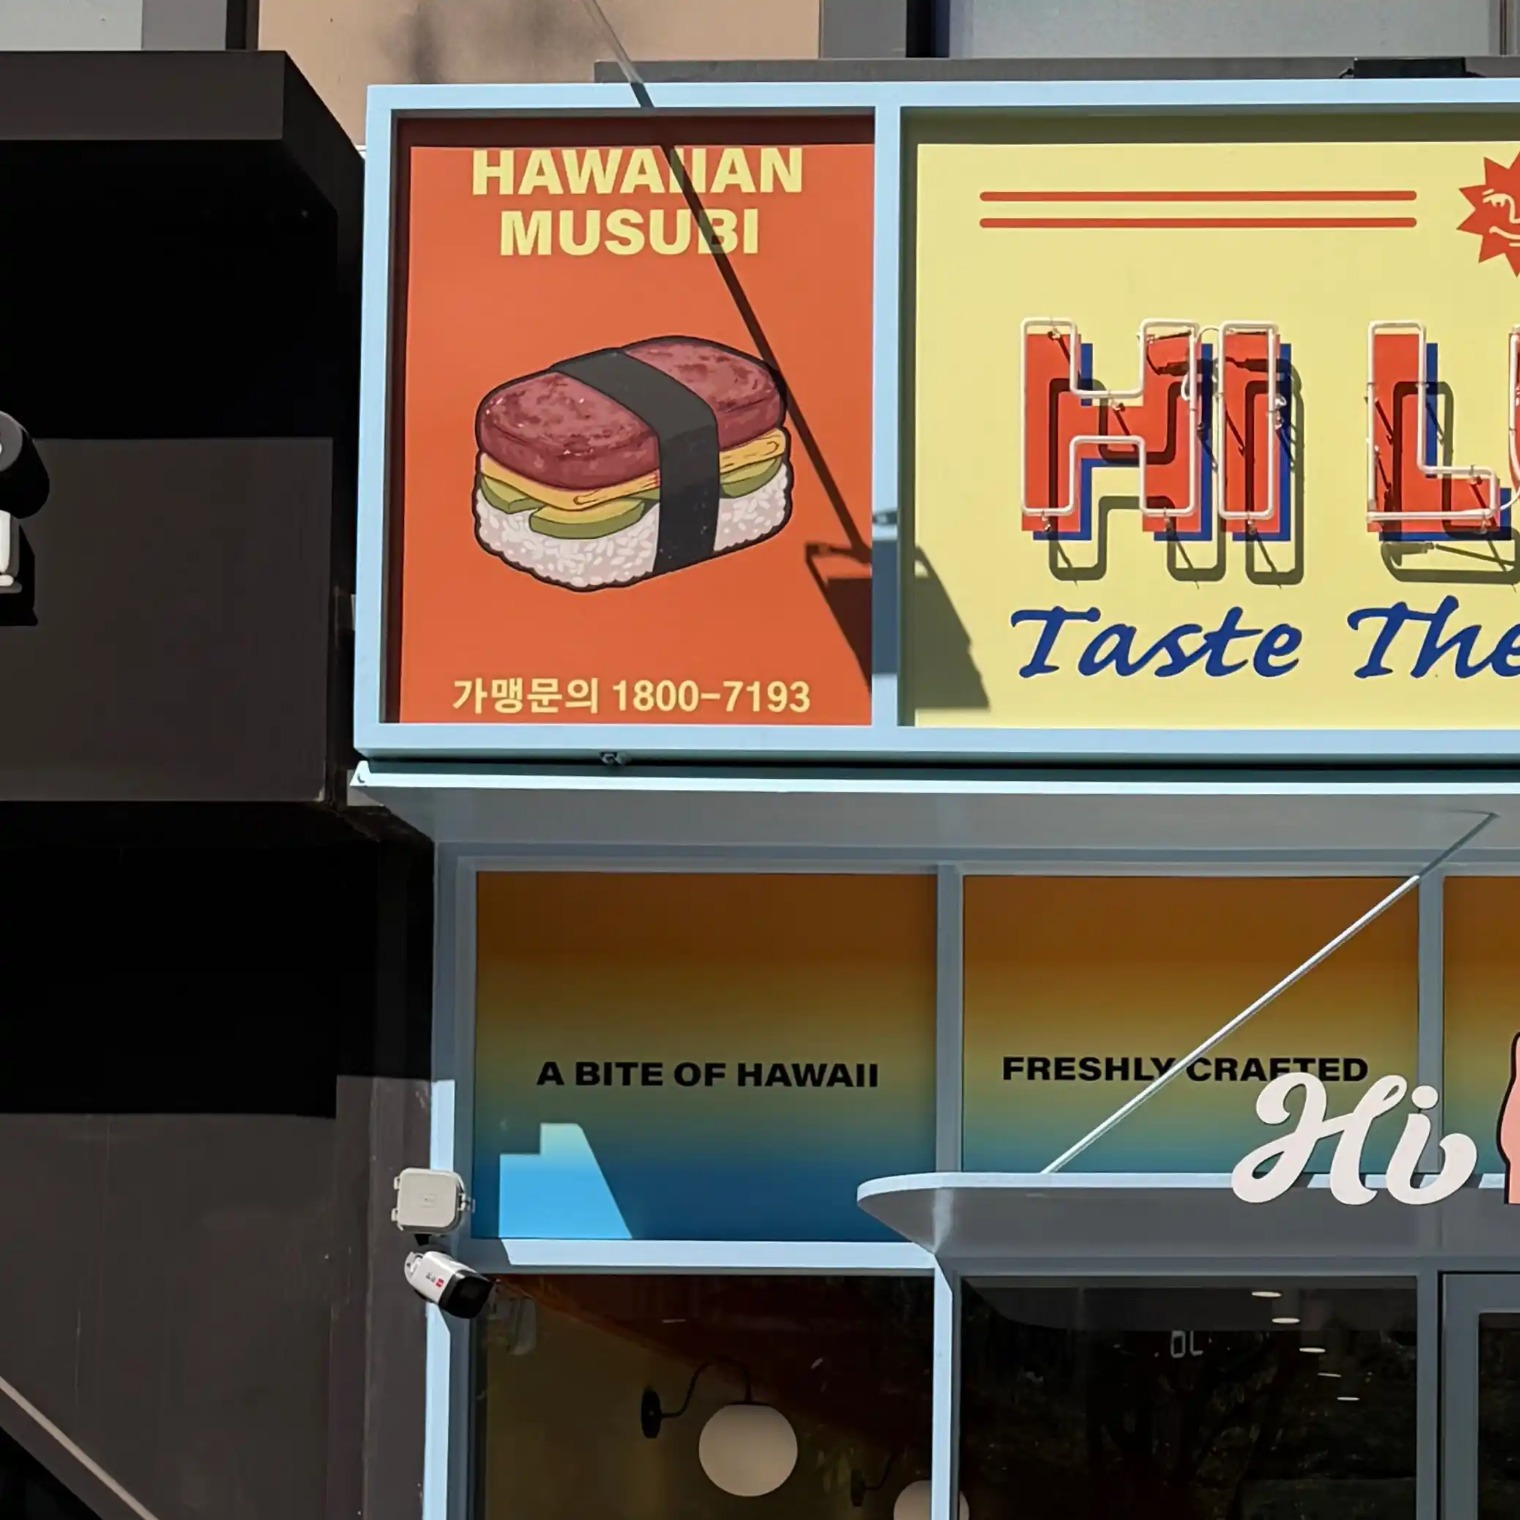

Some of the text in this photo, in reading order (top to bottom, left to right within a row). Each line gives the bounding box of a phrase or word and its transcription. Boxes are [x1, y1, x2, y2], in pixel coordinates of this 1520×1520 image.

[470, 145, 805, 196] HAWAIIAN
[499, 207, 760, 255] MUSUBI
[1020, 318, 1294, 542] HI
[1010, 602, 1302, 680] Taste
[452, 677, 812, 715] 가맹문의 1800-7193
[536, 1060, 879, 1089] A BITE OF HAWAII
[1002, 1057, 1369, 1082] FRESHLY CRAFTED
[1230, 1071, 1478, 1206] Hi
